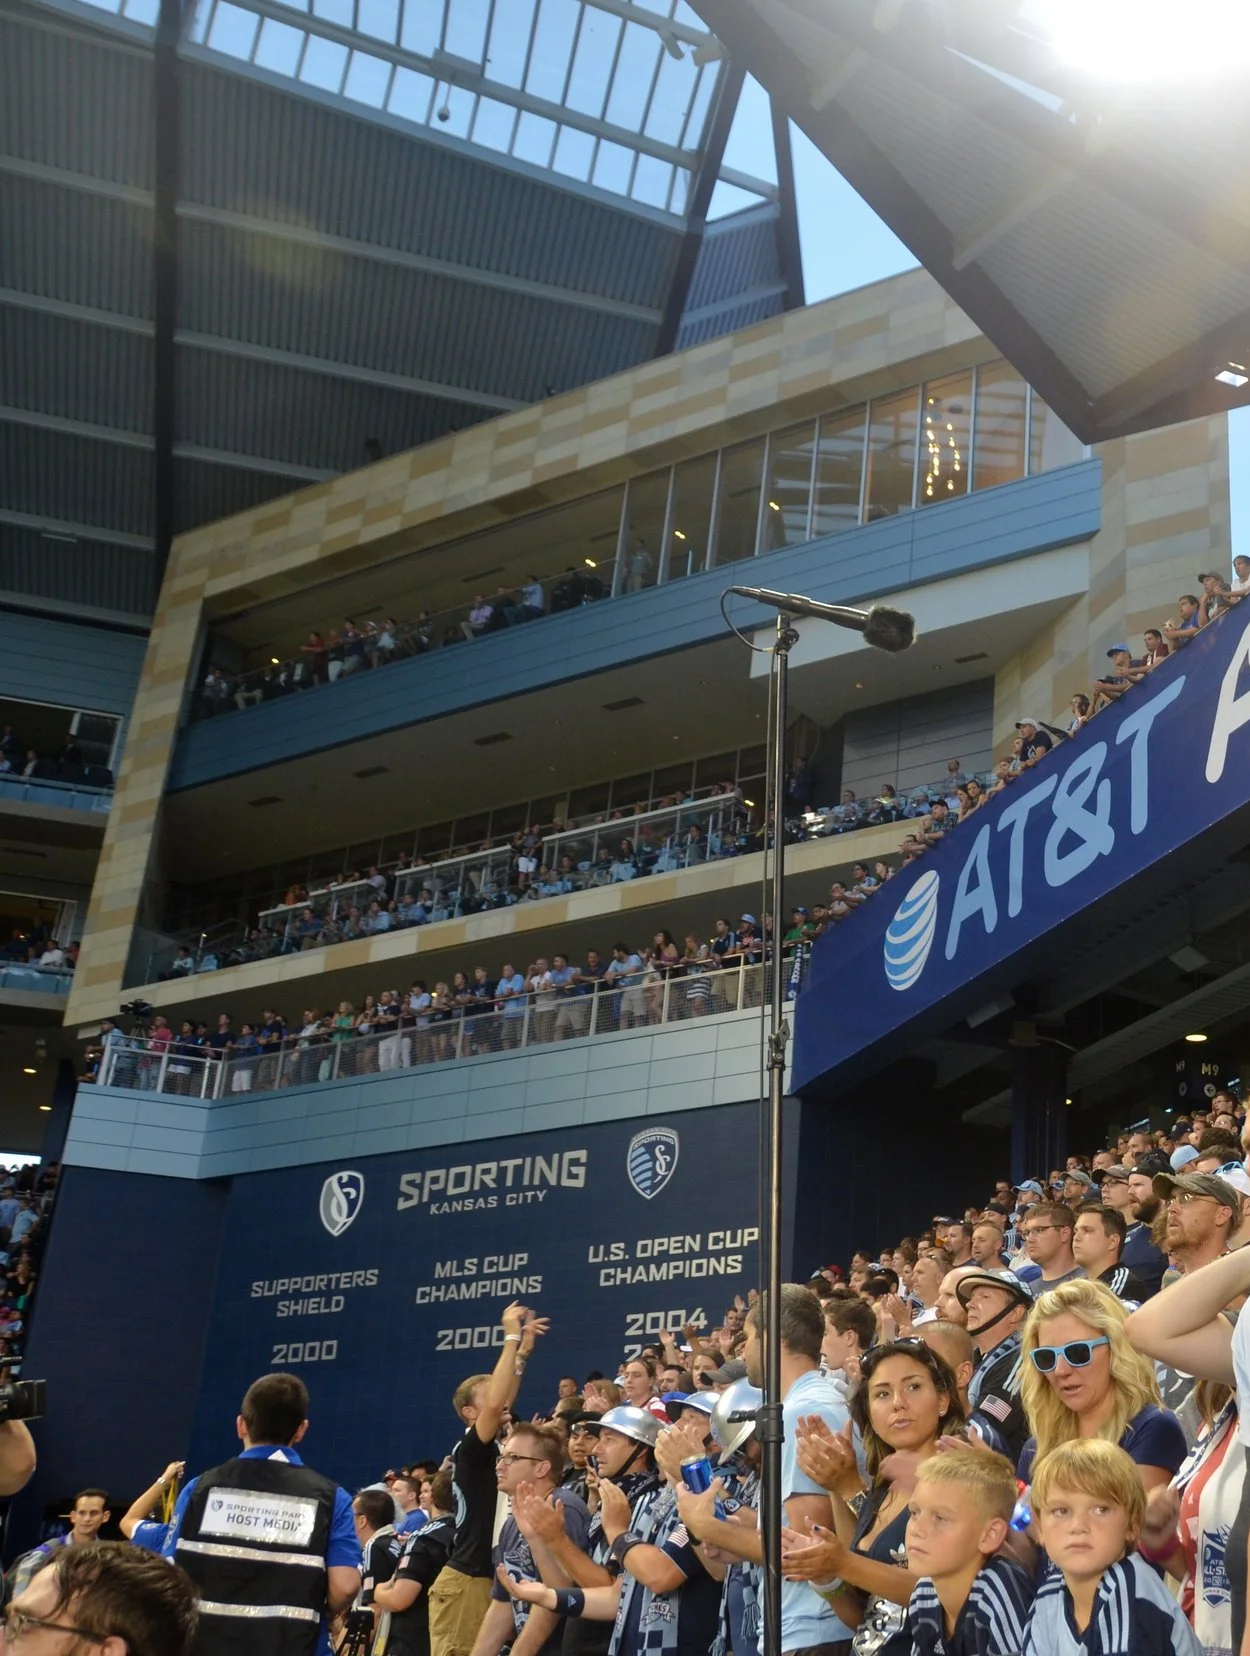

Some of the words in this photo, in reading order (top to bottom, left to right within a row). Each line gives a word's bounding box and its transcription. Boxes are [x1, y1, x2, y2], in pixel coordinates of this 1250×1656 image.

[945, 675, 1186, 961] AT&T
[1201, 1062, 1219, 1076] M9
[397, 1150, 588, 1211] SPORTING
[430, 1196, 498, 1215] KANSAS
[505, 1189, 548, 1206] CITY
[588, 1243, 630, 1263] U.S.
[636, 1233, 701, 1259] OPEN
[708, 1227, 759, 1250] CUP
[434, 1258, 478, 1279] MLS
[483, 1252, 528, 1274] CUP
[600, 1254, 743, 1287] CHAMPIONS
[251, 1269, 379, 1298] SUPPORTERS
[415, 1275, 543, 1305] CHAMPIONS
[276, 1296, 345, 1318] SHIELD
[624, 1308, 708, 1336] 2004
[271, 1340, 338, 1364] 2000
[226, 1502, 279, 1516] SPORTING
[226, 1513, 261, 1527] HOST
